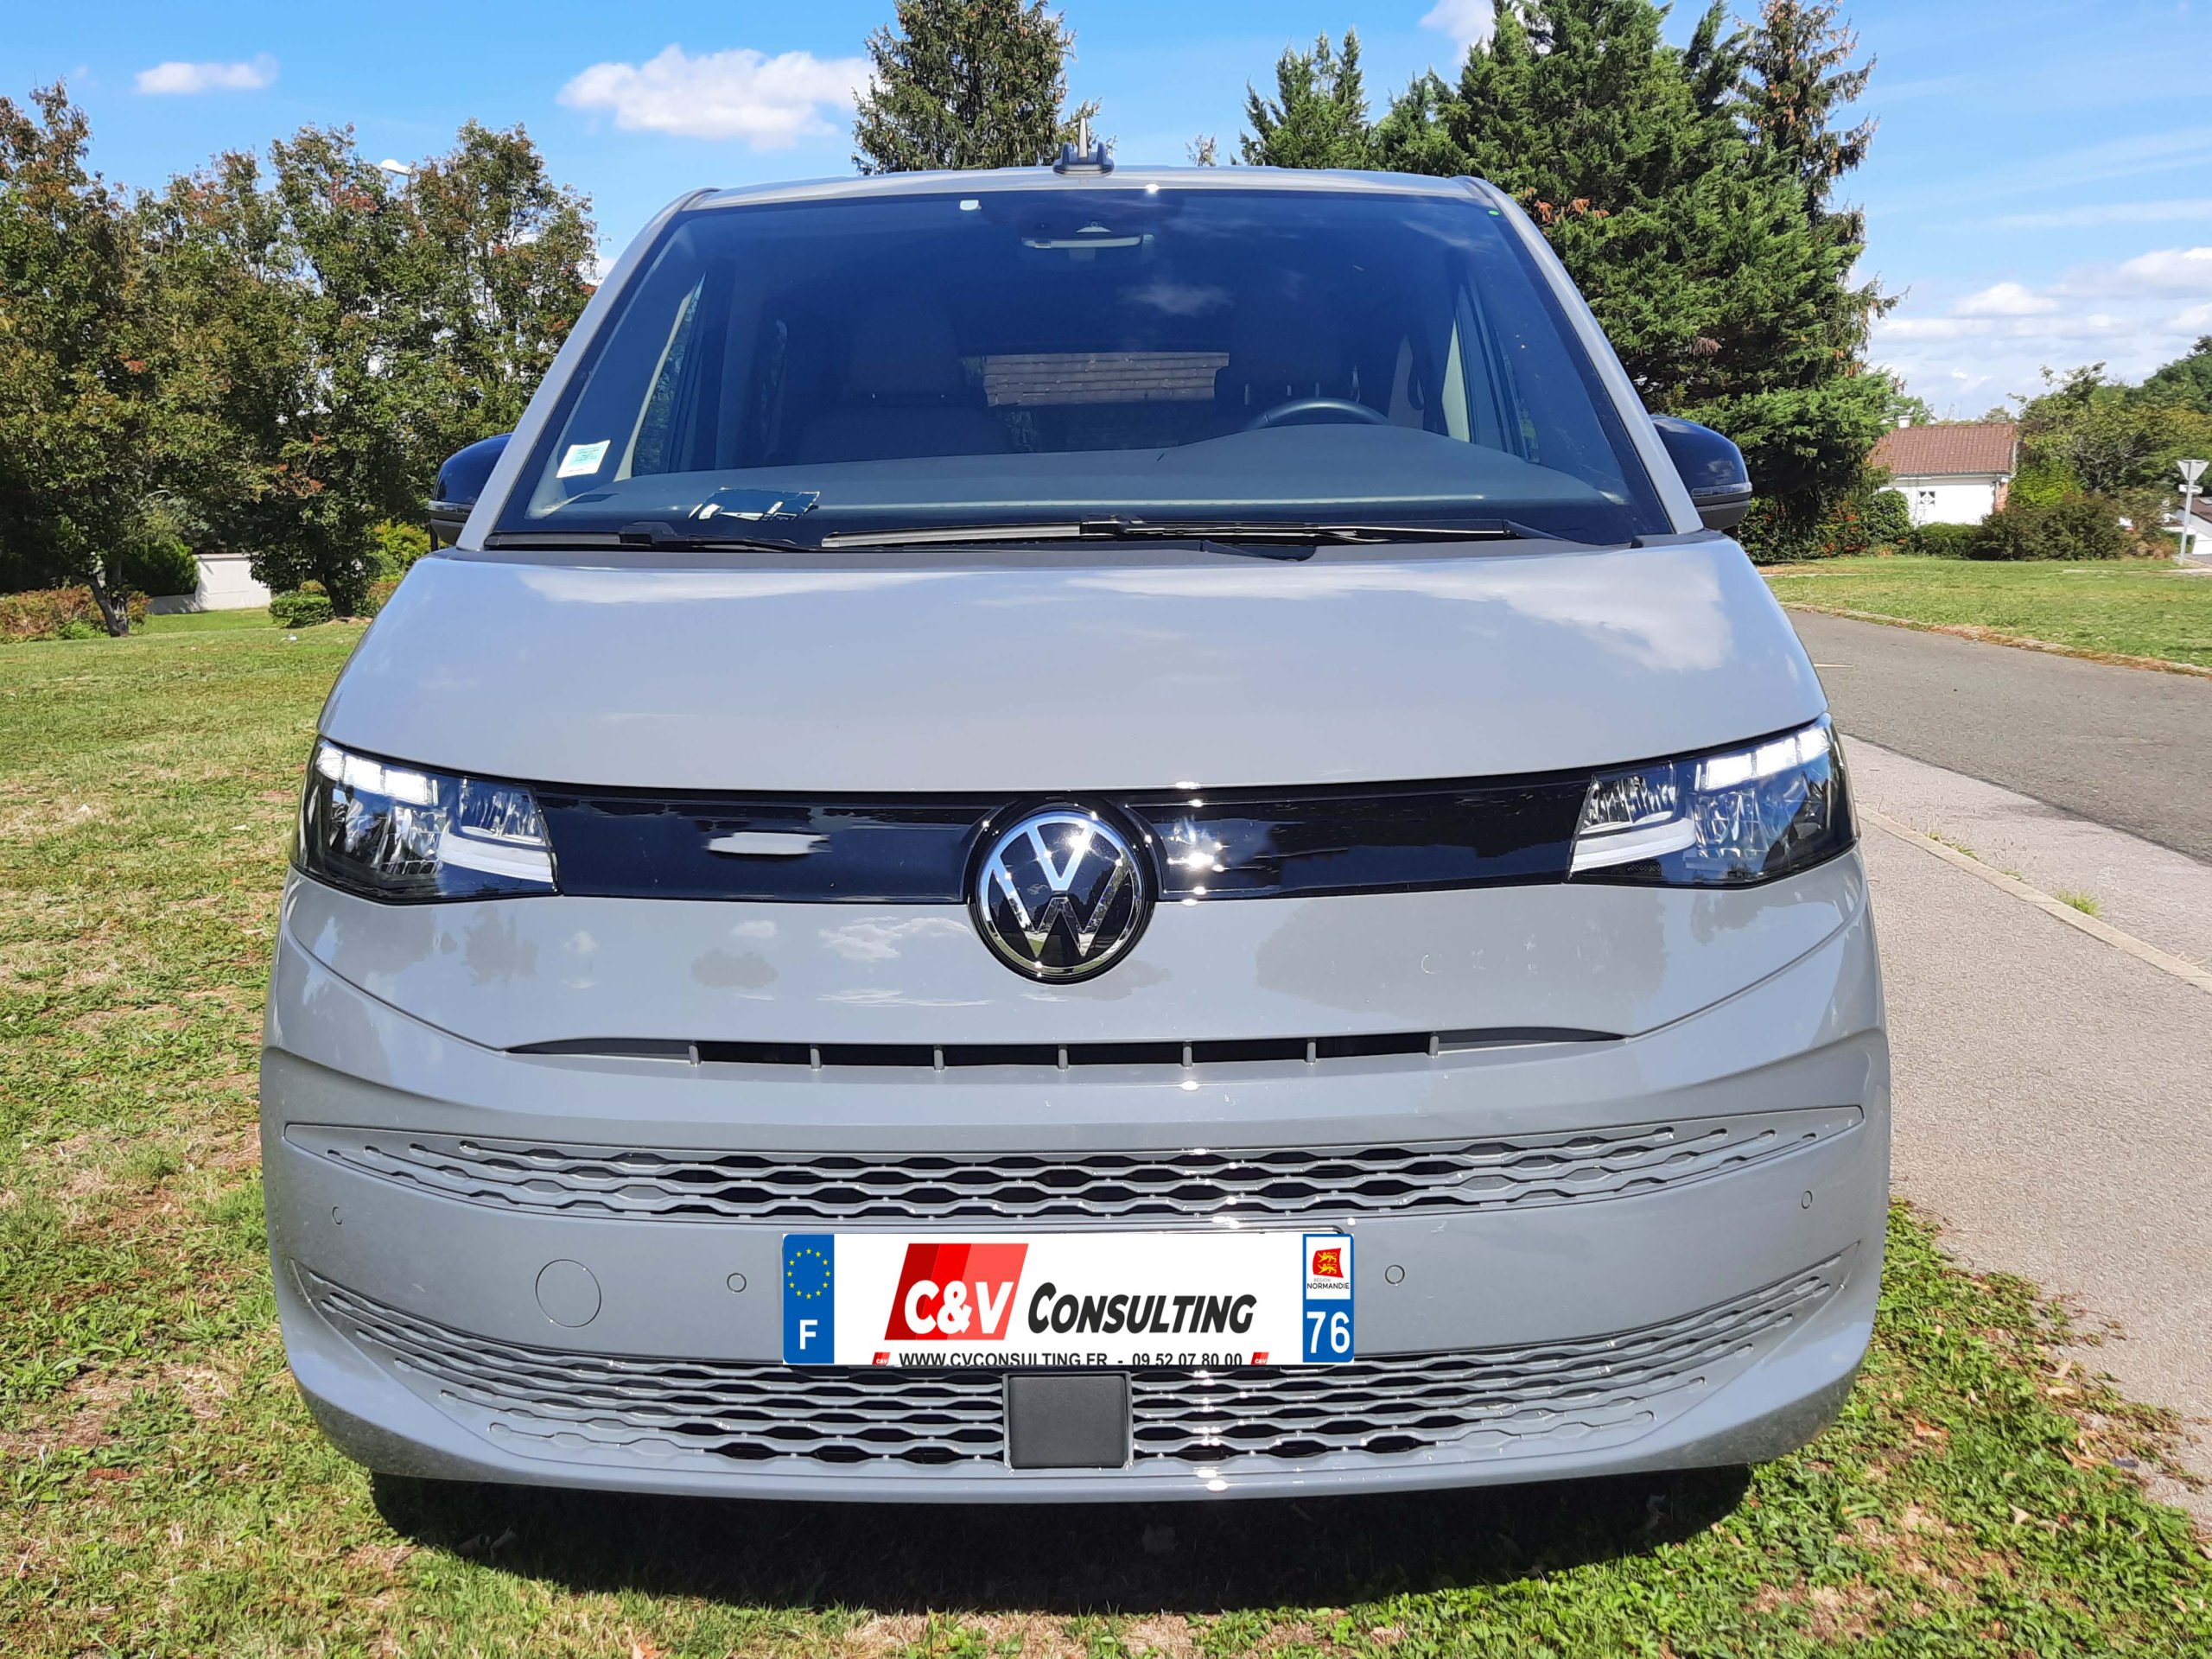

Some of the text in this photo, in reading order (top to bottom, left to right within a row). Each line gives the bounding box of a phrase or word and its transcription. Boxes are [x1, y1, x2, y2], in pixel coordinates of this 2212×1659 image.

[904, 1280, 1257, 1335] C&V CONSULTING
[799, 1319, 818, 1350] F
[1306, 1311, 1351, 1354] 76
[899, 1352, 1108, 1365] WWW.CVCONSULTINGFR
[1132, 1352, 1150, 1365] 09
[1155, 1352, 1173, 1365] 52
[1178, 1352, 1197, 1365] 07
[1201, 1352, 1219, 1365] 80
[1224, 1352, 1243, 1365] 00
